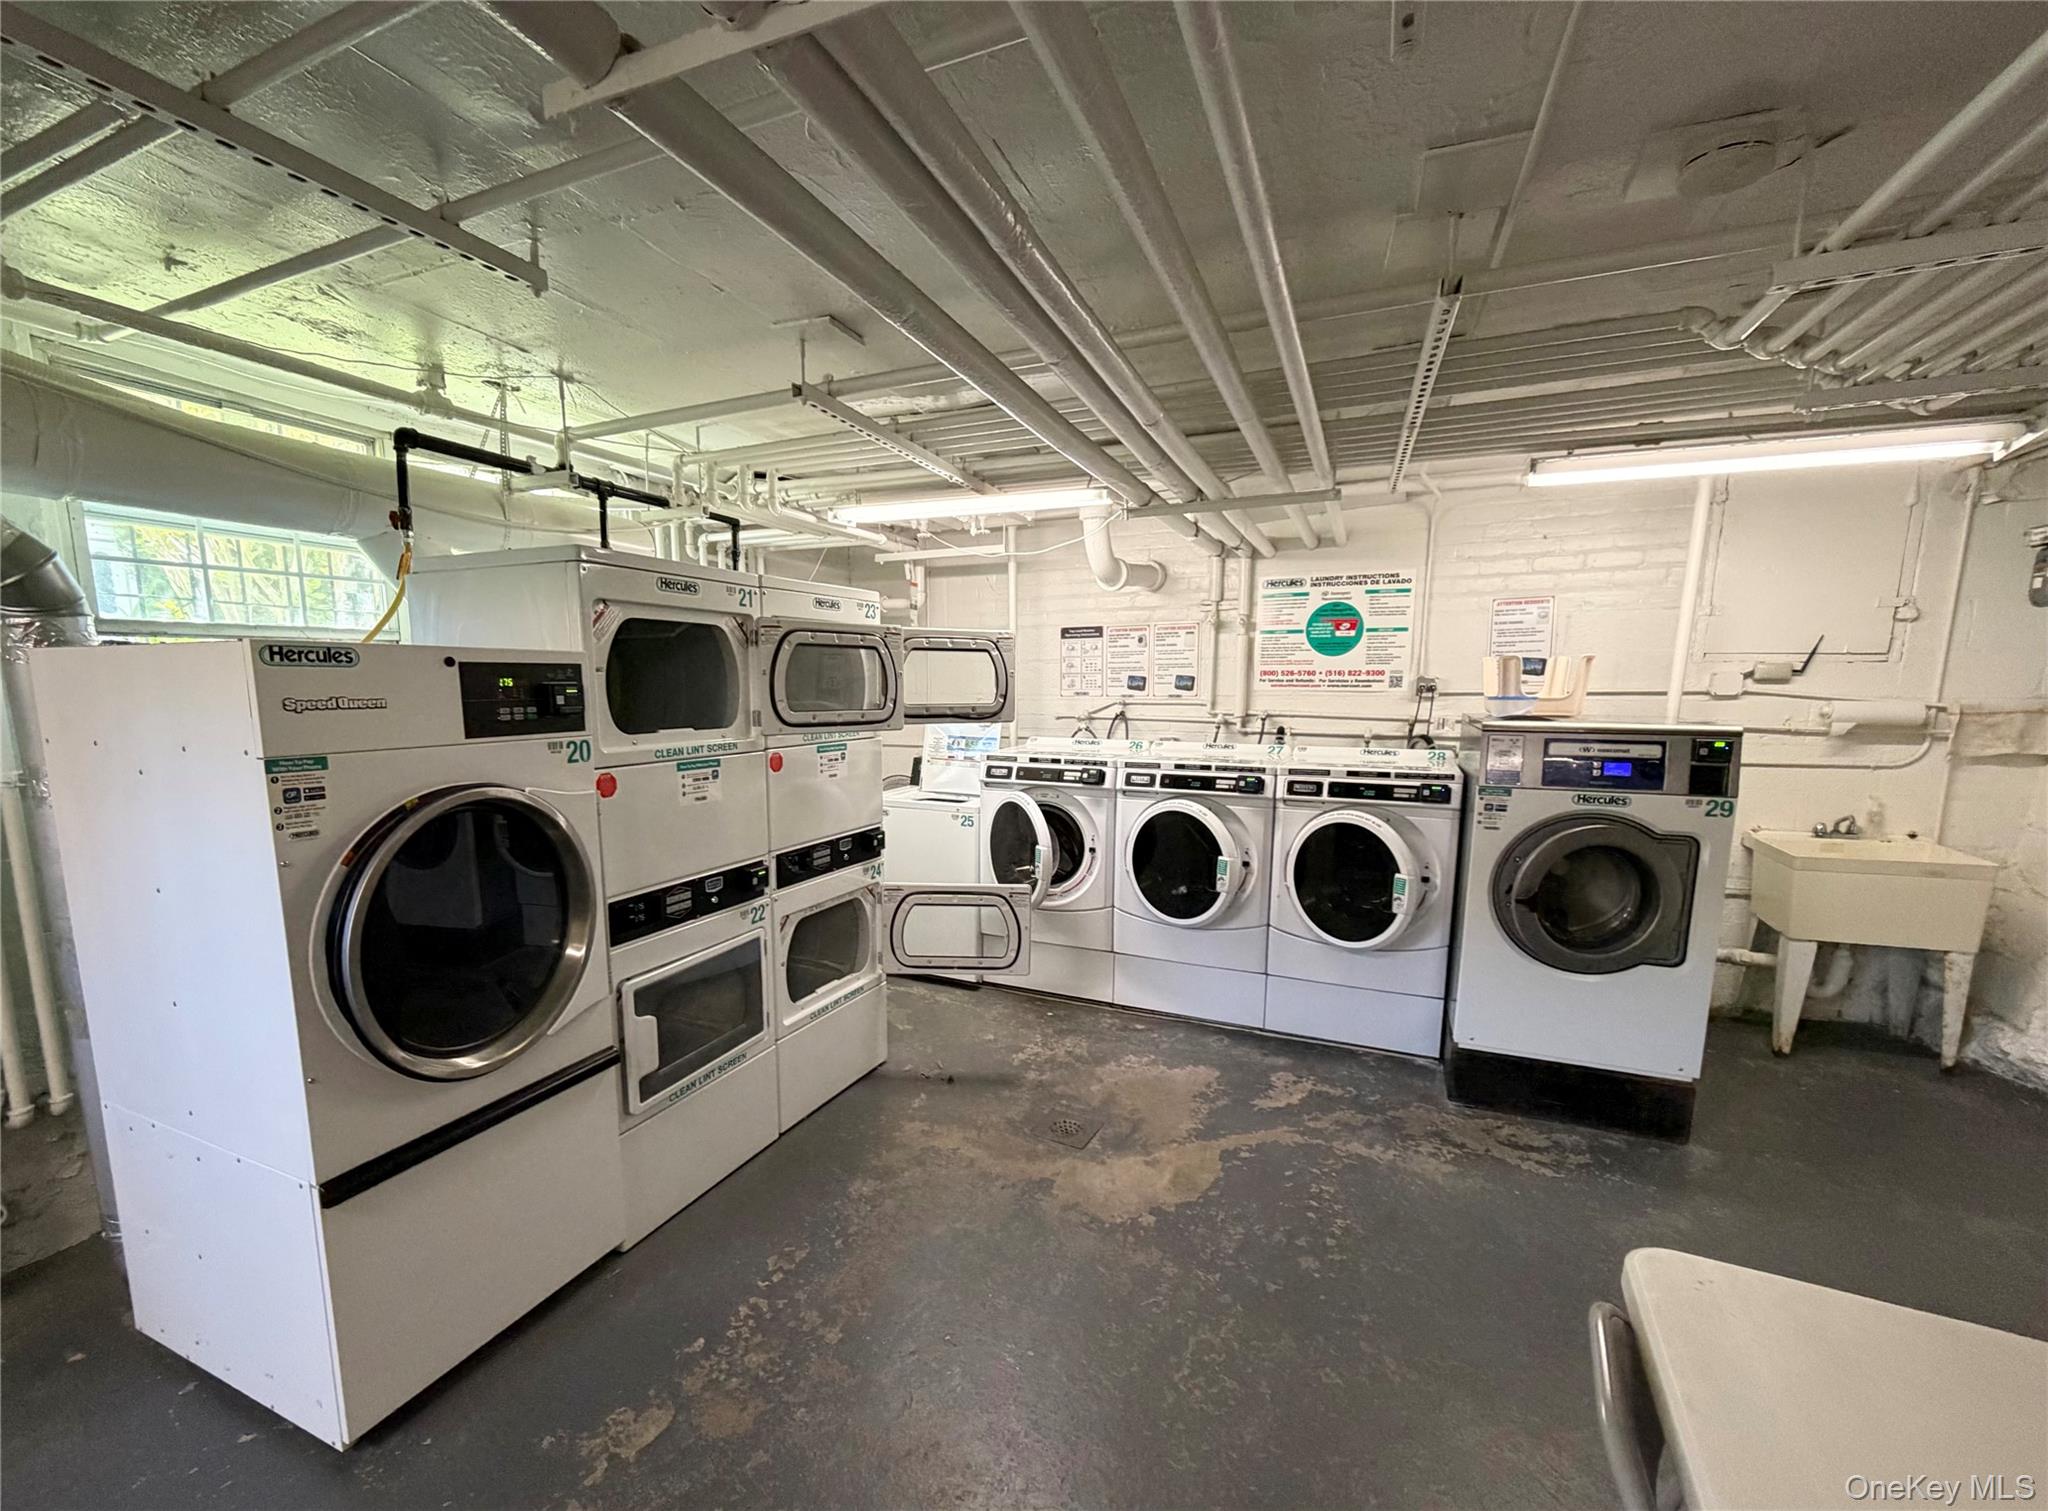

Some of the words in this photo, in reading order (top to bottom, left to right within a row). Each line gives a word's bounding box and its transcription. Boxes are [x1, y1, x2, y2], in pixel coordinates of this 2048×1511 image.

[659, 578, 698, 593] Hercules
[1266, 578, 1304, 588] Hercules
[1310, 580, 1368, 588] INSTRUCCIONES
[738, 588, 753, 607] 21
[815, 597, 841, 610] Hercules
[864, 603, 877, 620] 23
[268, 644, 354, 664] Hercules
[802, 733, 823, 742] CLEAN
[566, 740, 591, 763] 20
[654, 747, 685, 760] CLEAN
[686, 745, 705, 756] LINT
[706, 742, 739, 754] SCREEN
[1129, 741, 1143, 751] 26
[1267, 745, 1284, 755] 27
[1427, 751, 1447, 761] 28
[1576, 794, 1628, 806] Hercules
[1704, 799, 1734, 817] 29
[960, 815, 975, 828] 25
[870, 863, 882, 879] 24
[750, 905, 766, 924] 22
[809, 1003, 829, 1020] CLEAN
[829, 997, 843, 1010] LINT
[843, 986, 865, 1003] SCREEN
[668, 1080, 698, 1102] CLEAN
[699, 1069, 717, 1086] LINT
[717, 1052, 748, 1076] SCREEN
